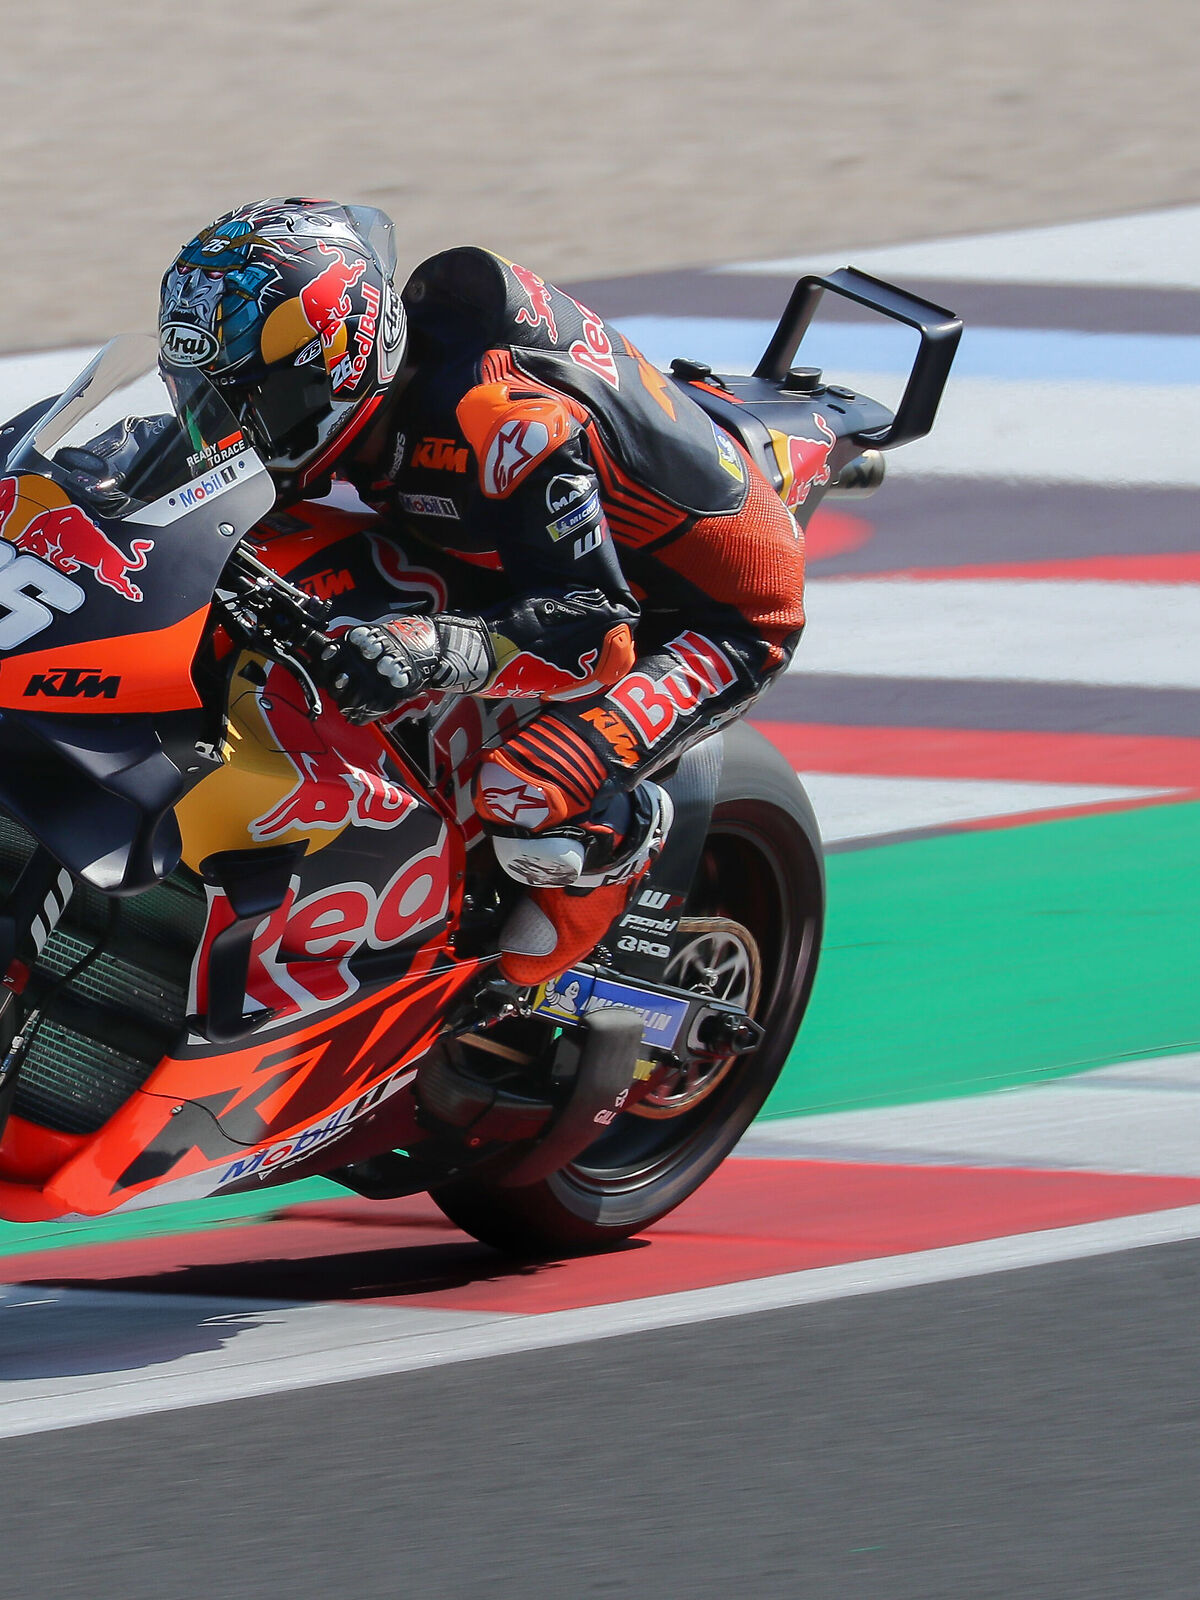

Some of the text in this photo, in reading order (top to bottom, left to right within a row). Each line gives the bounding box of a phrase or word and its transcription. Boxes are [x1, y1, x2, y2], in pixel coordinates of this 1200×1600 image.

[201, 239, 231, 253] 26
[162, 328, 208, 354] Arai
[343, 281, 381, 391] Red Bull
[186, 443, 218, 468] READY
[207, 440, 246, 469] TO RACE
[411, 437, 469, 473] KTM
[179, 473, 223, 508] Mobil
[298, 568, 356, 600] KTM
[22, 668, 124, 699] KTM
[604, 629, 739, 750] Bull
[578, 706, 641, 768] KTM
[218, 1107, 349, 1184] Mobil
